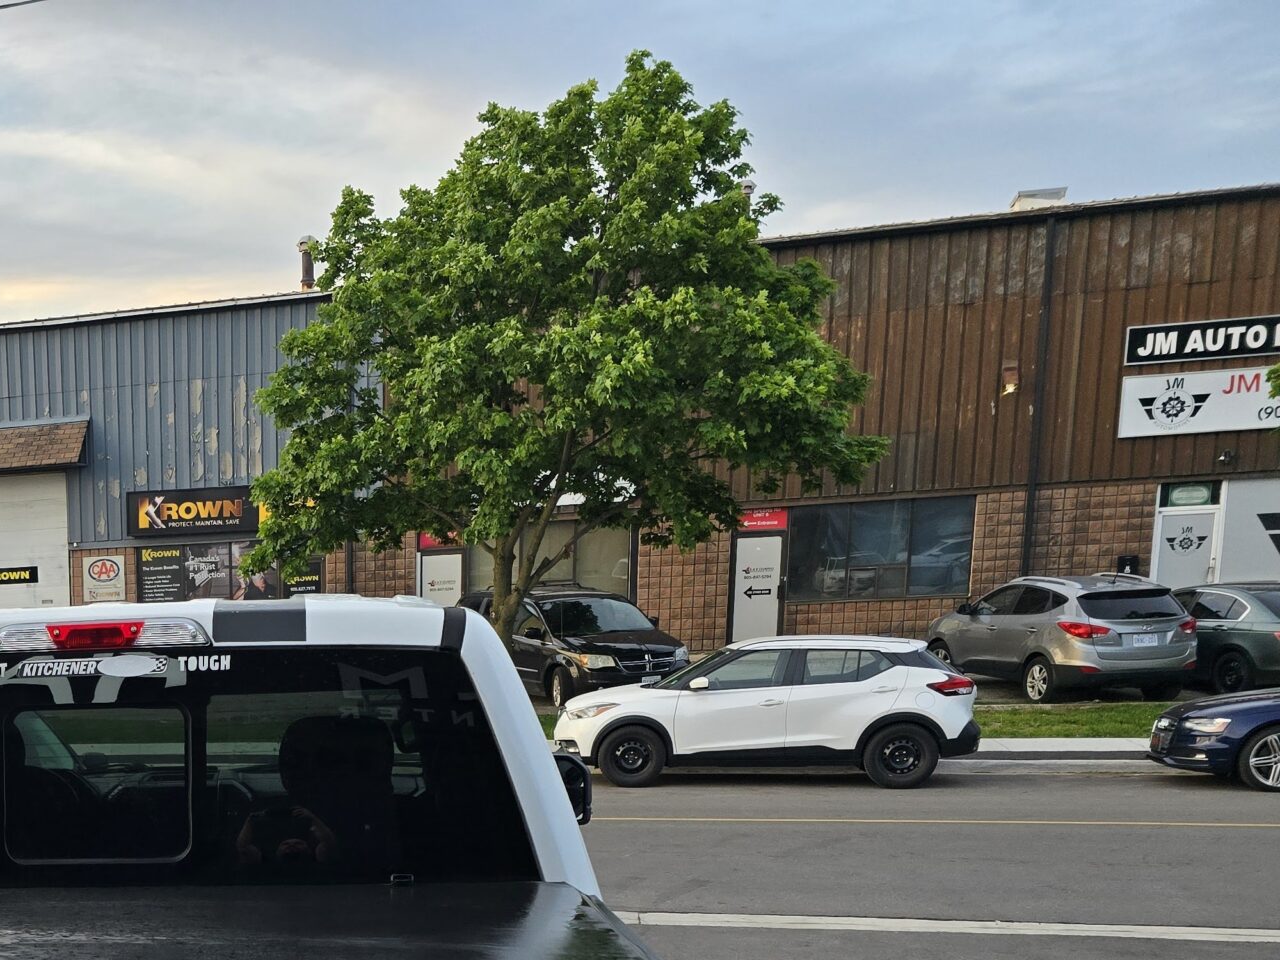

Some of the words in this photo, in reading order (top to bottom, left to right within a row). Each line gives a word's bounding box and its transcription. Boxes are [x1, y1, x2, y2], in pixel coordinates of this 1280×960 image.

[1137, 331, 1178, 356] JM
[1184, 324, 1268, 353] AUTO
[1165, 377, 1185, 391] JM
[1222, 373, 1261, 394] JM
[138, 495, 243, 529] KROWN
[141, 548, 180, 561] KROWN
[188, 554, 220, 562] Canada's
[91, 560, 116, 578] CAA
[200, 562, 216, 571] Rust
[22, 660, 96, 677] KITCHENER
[177, 654, 231, 672] TOUGH
